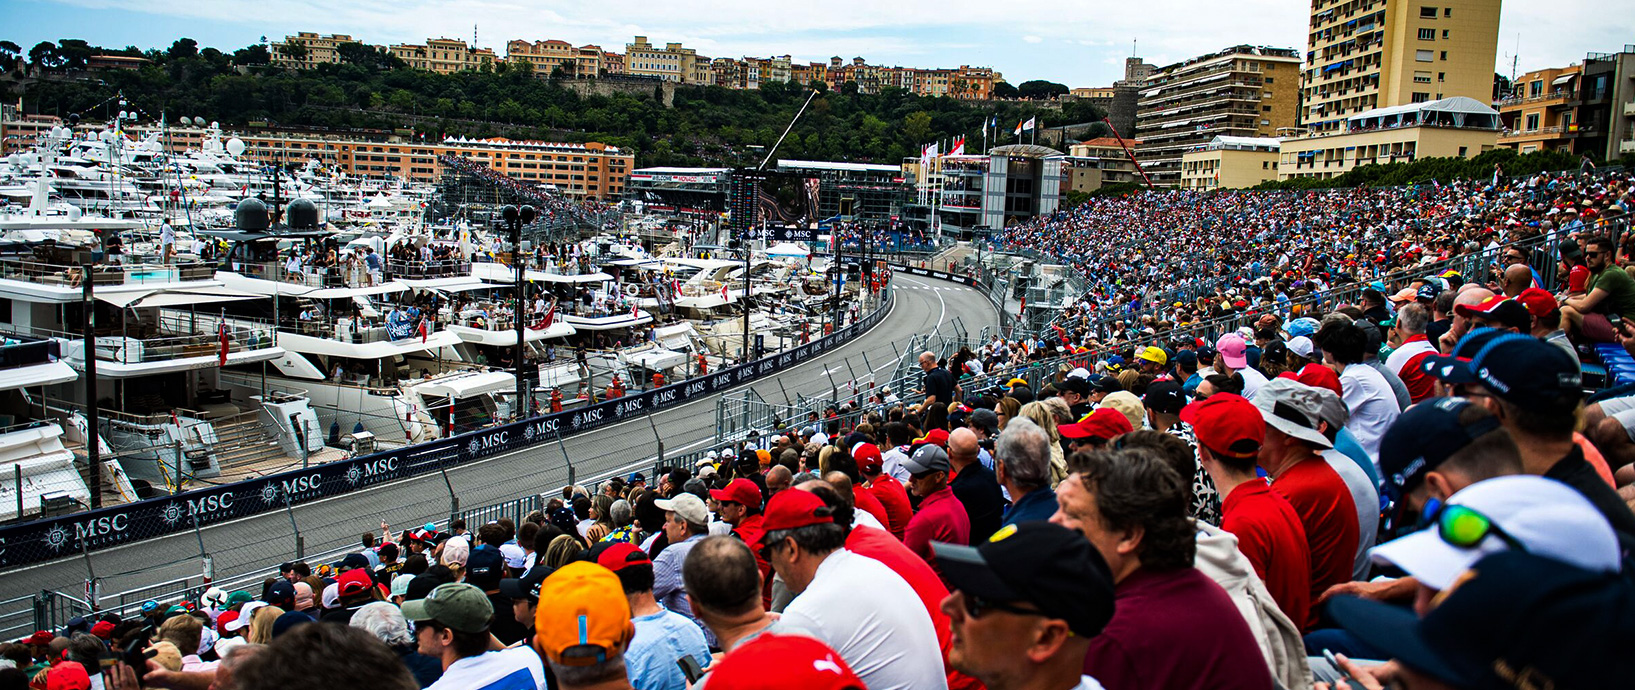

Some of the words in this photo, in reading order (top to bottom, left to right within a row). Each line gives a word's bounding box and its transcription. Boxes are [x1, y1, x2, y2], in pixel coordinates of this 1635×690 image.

[793, 230, 811, 238] MSC
[691, 380, 706, 394] MSC
[718, 372, 731, 386] MSC
[660, 389, 676, 403] MSC
[624, 397, 643, 413] MSC
[582, 407, 604, 424] MSC
[536, 418, 560, 435] MSC
[481, 431, 509, 449] MSC
[364, 456, 398, 477] MSC
[281, 473, 321, 494] MSC
[187, 492, 233, 516] MSC
[74, 513, 128, 540] MSC
